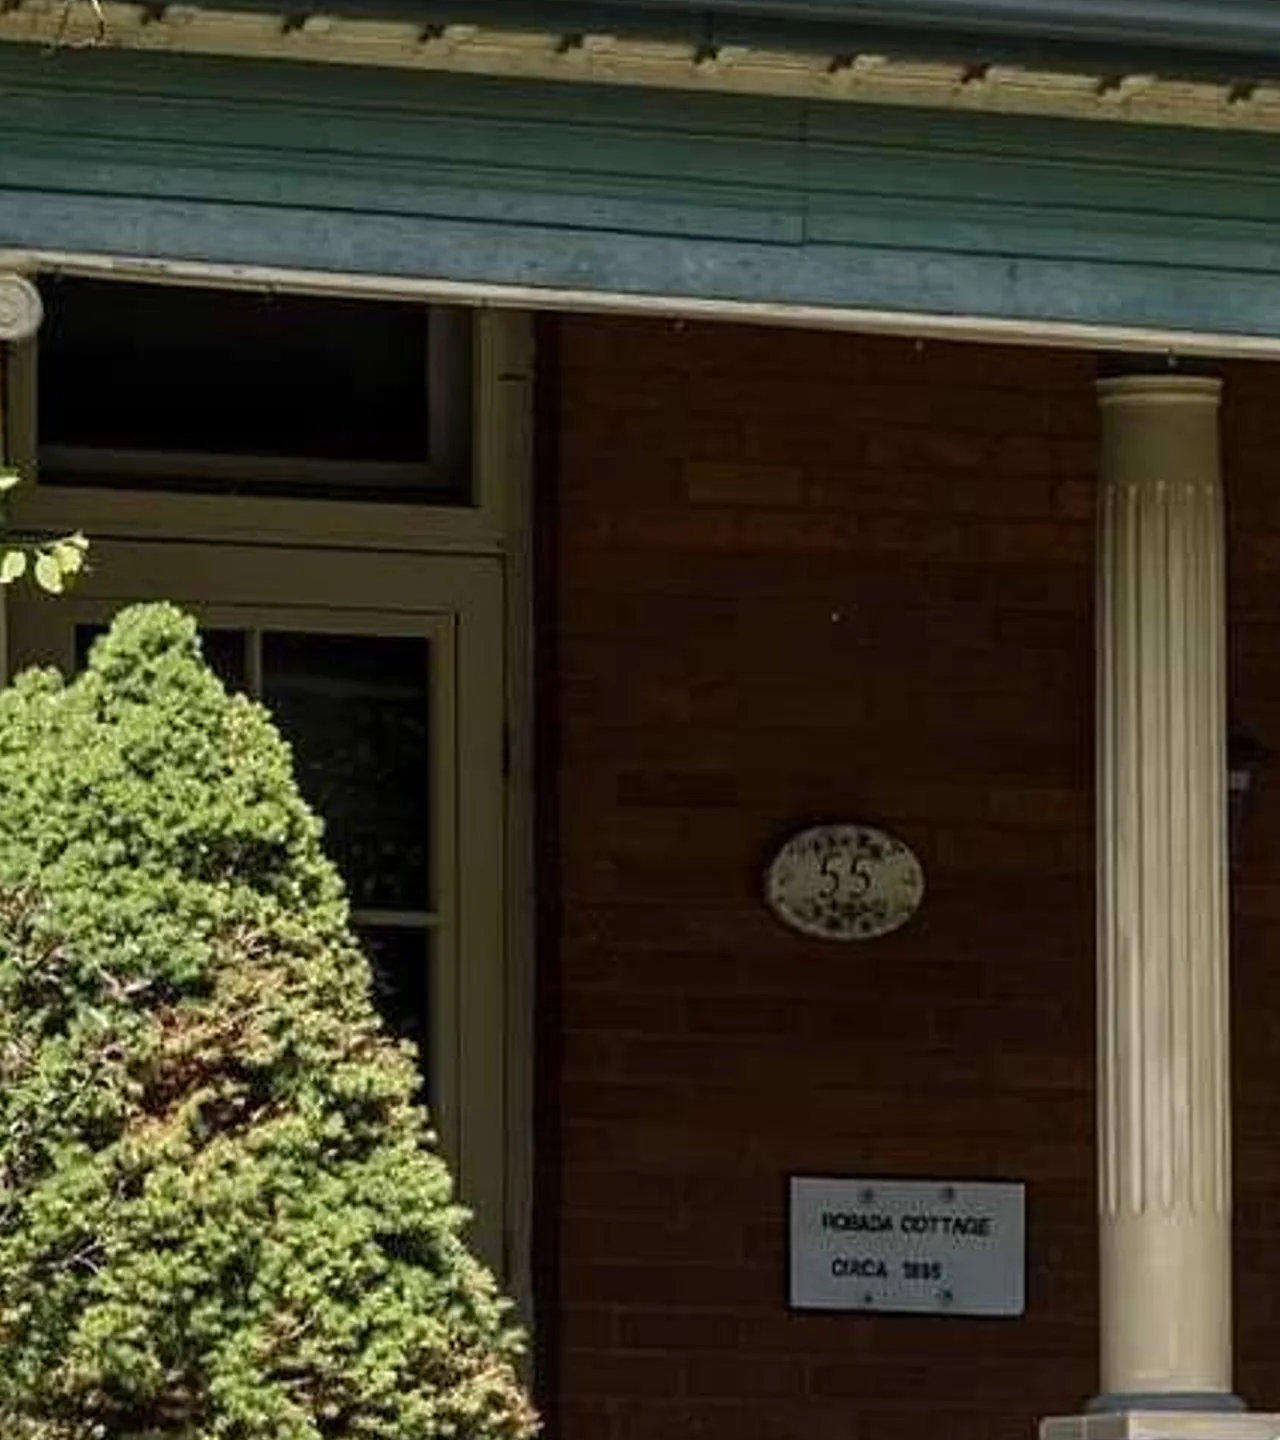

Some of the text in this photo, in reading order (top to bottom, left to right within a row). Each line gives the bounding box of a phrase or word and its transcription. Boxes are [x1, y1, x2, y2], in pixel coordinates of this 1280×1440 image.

[818, 854, 876, 898] 55
[900, 1214, 993, 1237] COTTAGE
[831, 1257, 888, 1278] CIRCA
